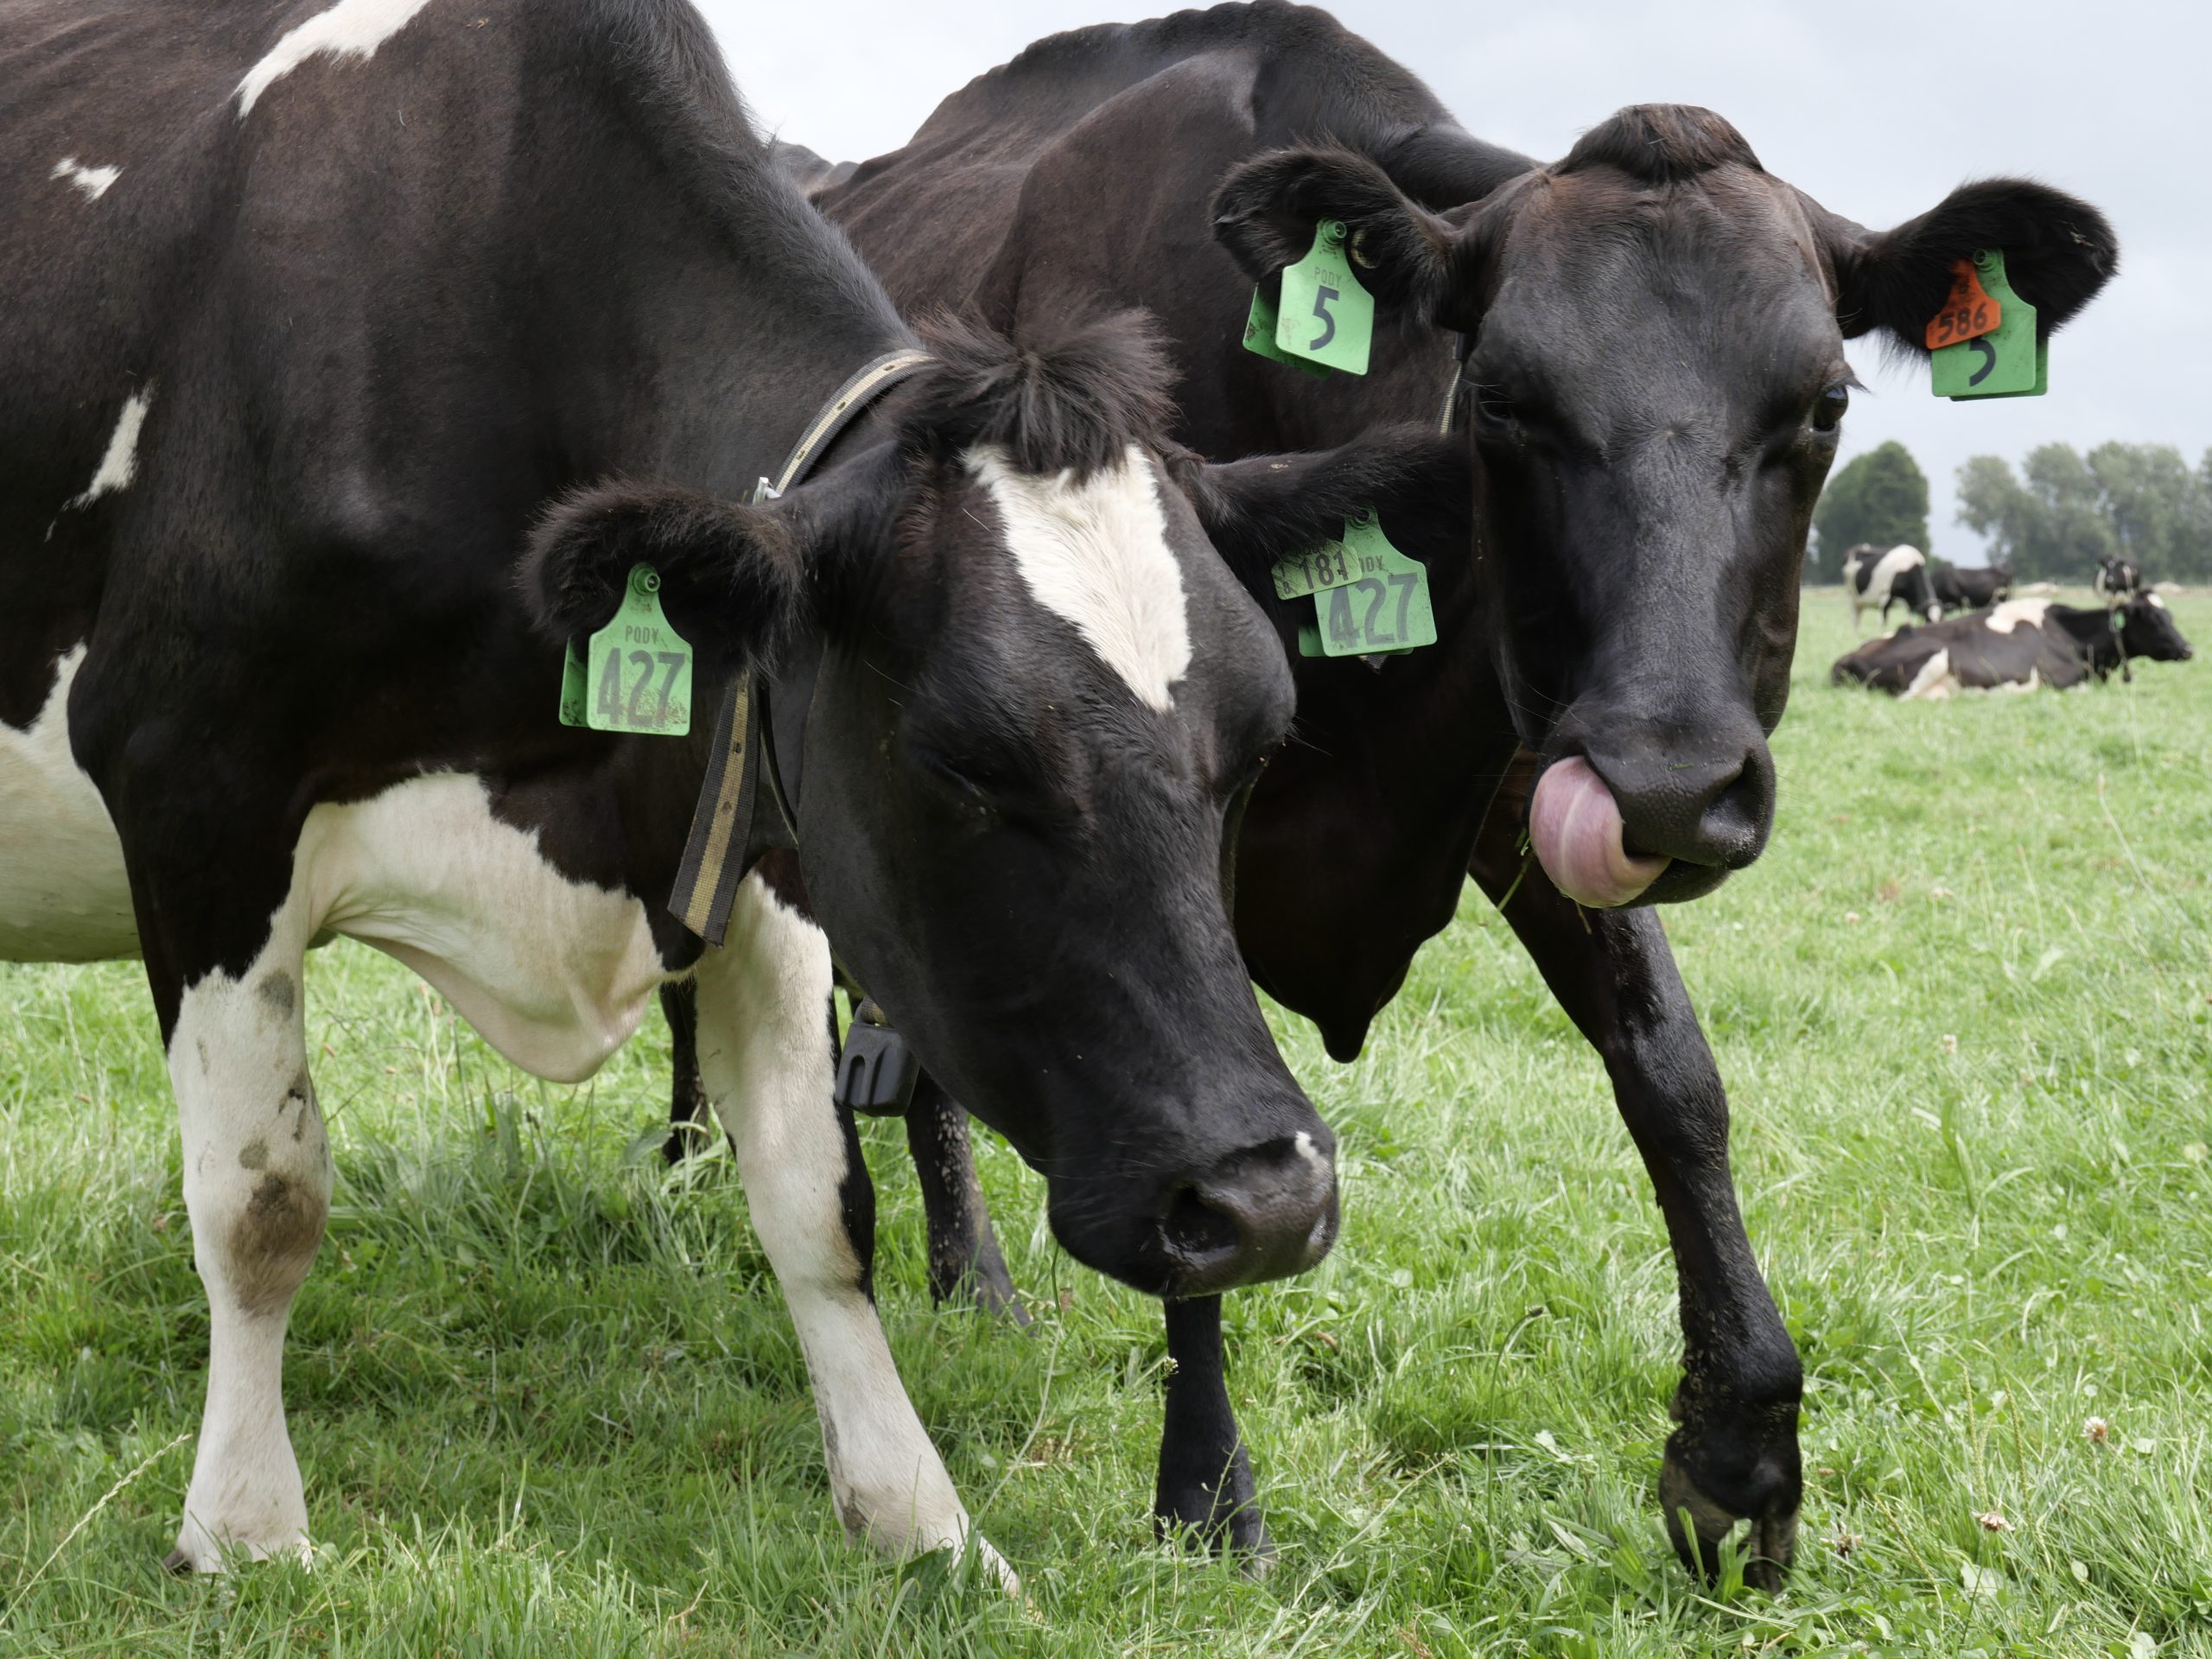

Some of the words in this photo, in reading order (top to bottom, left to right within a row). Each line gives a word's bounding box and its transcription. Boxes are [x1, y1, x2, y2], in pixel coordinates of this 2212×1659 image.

[1309, 284, 1339, 351] 5
[1938, 302, 1987, 344] 586
[1299, 550, 1349, 590] 181
[1329, 572, 1419, 648] 427
[597, 647, 685, 728] 427
